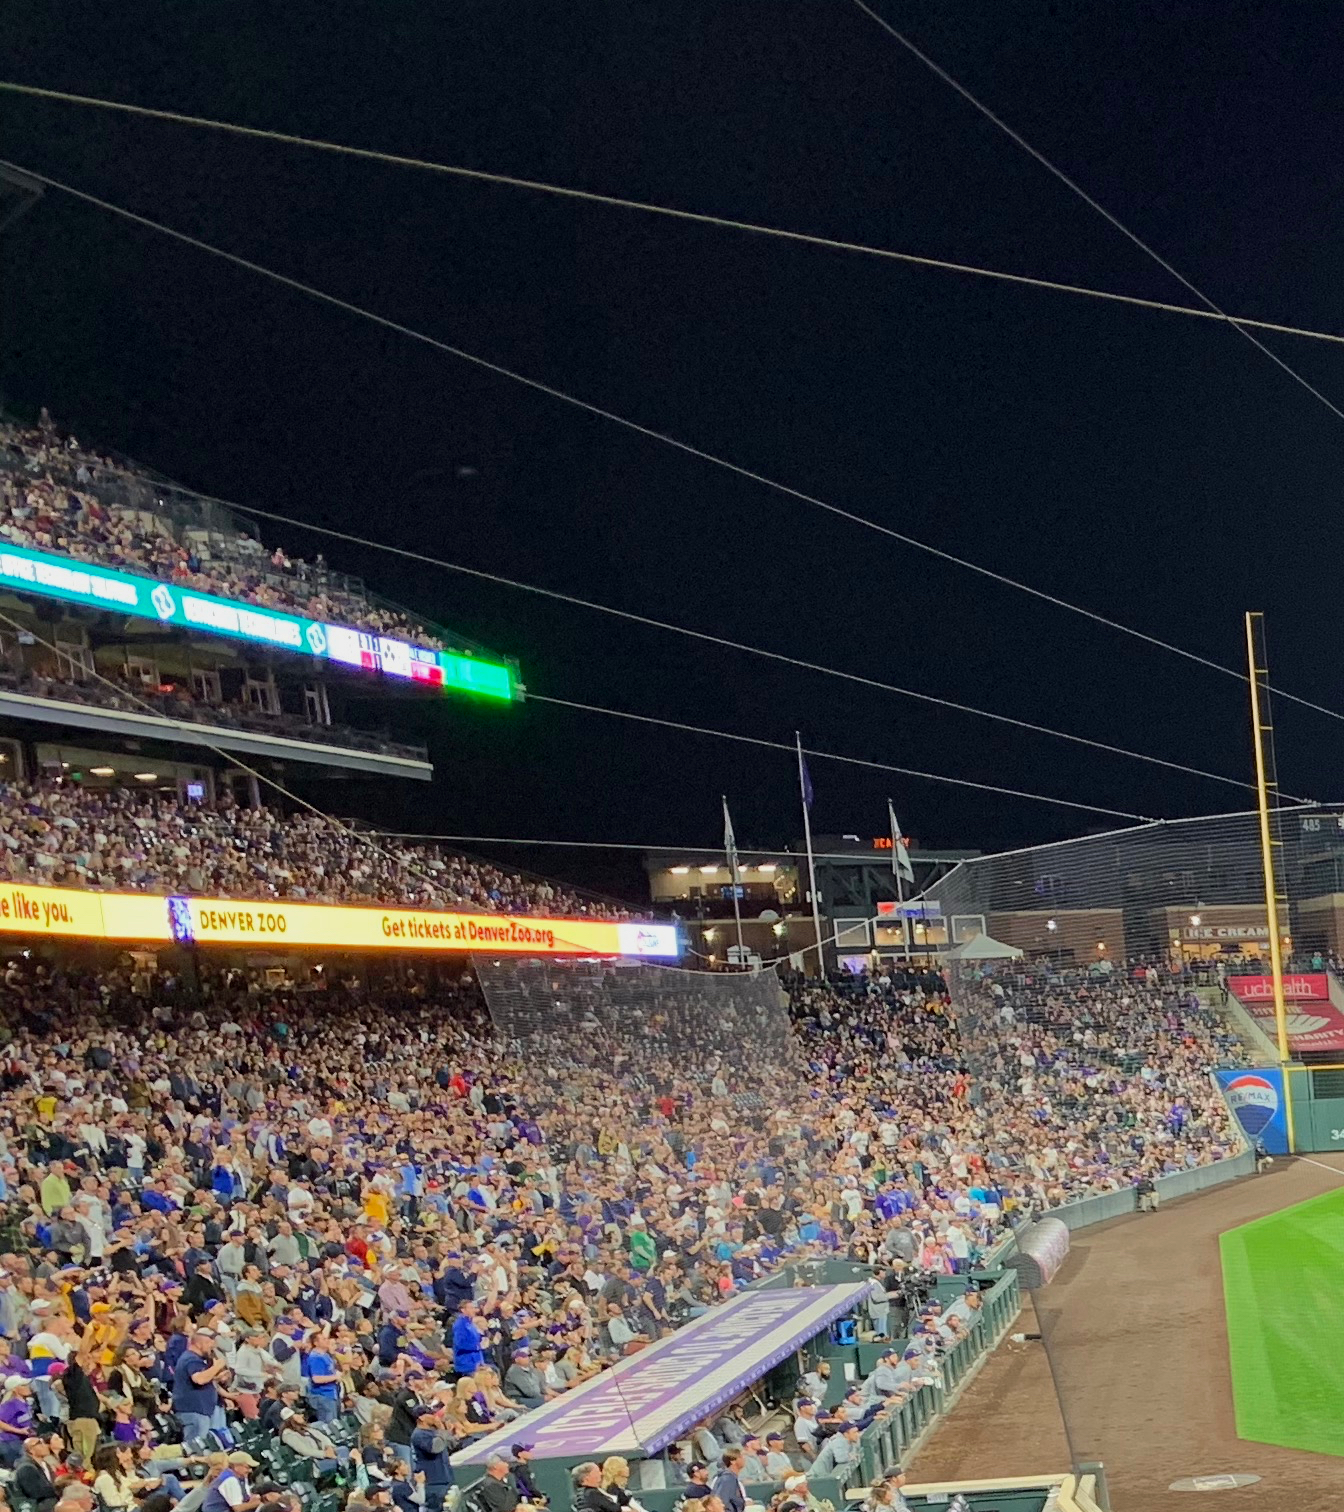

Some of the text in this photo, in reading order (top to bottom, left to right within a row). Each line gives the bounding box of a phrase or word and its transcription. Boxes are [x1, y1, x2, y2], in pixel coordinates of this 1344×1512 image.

[13, 891, 40, 919] like
[43, 901, 74, 928] you.
[200, 909, 287, 933] DENVER ZOO
[381, 915, 554, 948] Get tickets at DenverZoo.org
[1189, 927, 1269, 938] ICE CREAM
[1244, 977, 1312, 996] uchalth
[1230, 1091, 1271, 1103] RE/MAX
